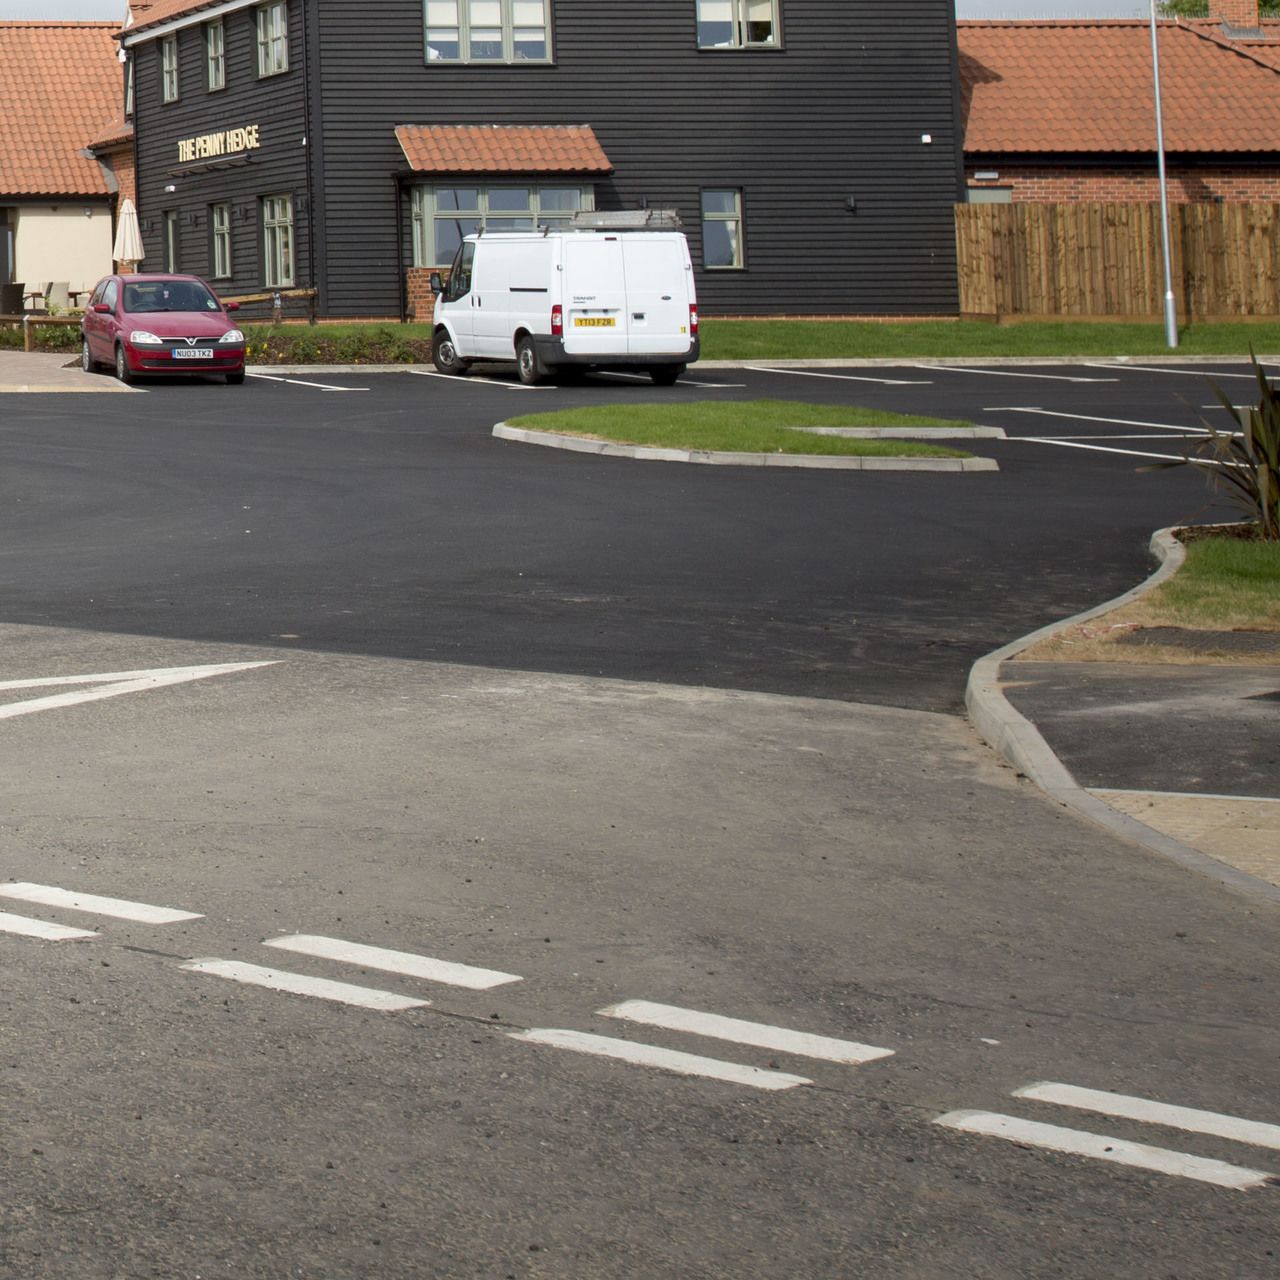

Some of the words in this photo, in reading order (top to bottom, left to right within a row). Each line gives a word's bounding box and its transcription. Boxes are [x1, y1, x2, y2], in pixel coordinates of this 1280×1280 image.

[178, 138, 196, 162] THE
[195, 132, 225, 159] PENNY
[226, 124, 260, 153] HEDGE
